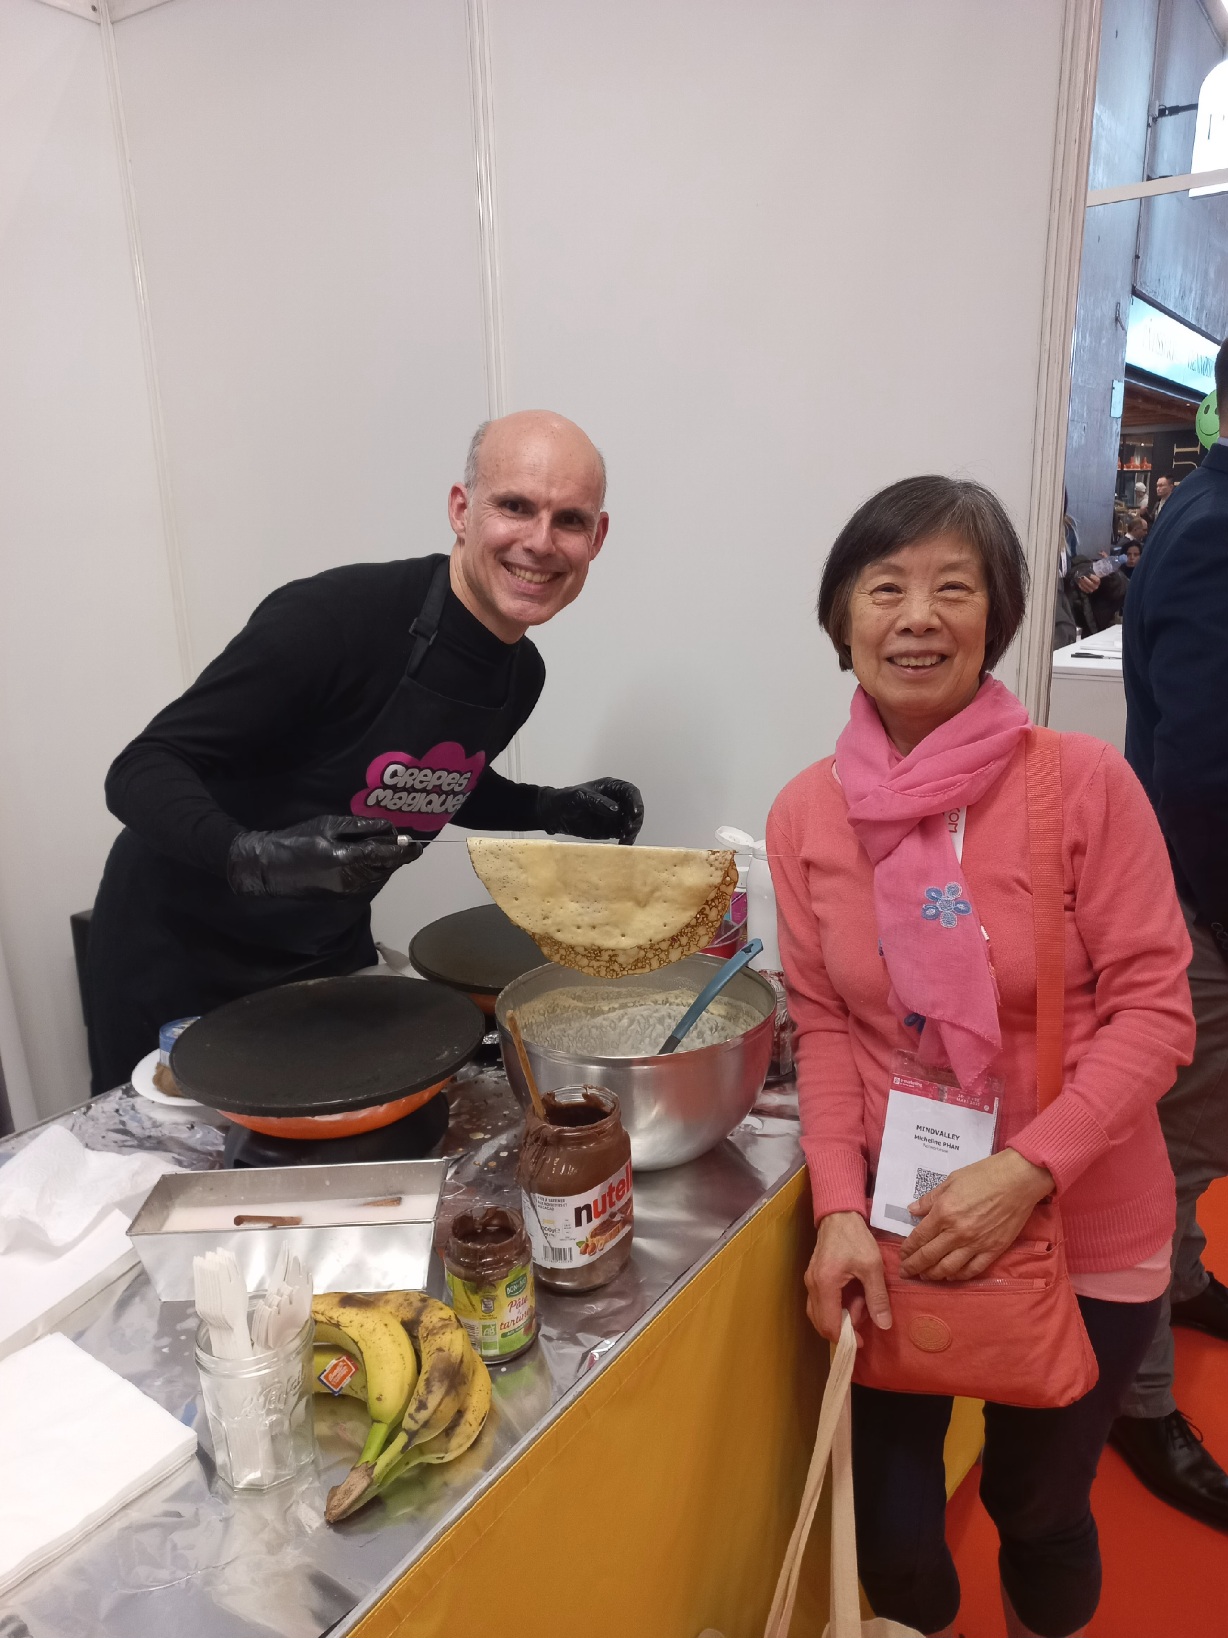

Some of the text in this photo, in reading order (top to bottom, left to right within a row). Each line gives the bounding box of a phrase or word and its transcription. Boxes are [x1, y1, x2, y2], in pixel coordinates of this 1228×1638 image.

[916, 1125, 960, 1141] MINDVALLEY
[914, 1134, 942, 1147] Micheline
[942, 1141, 960, 1151] PHAN
